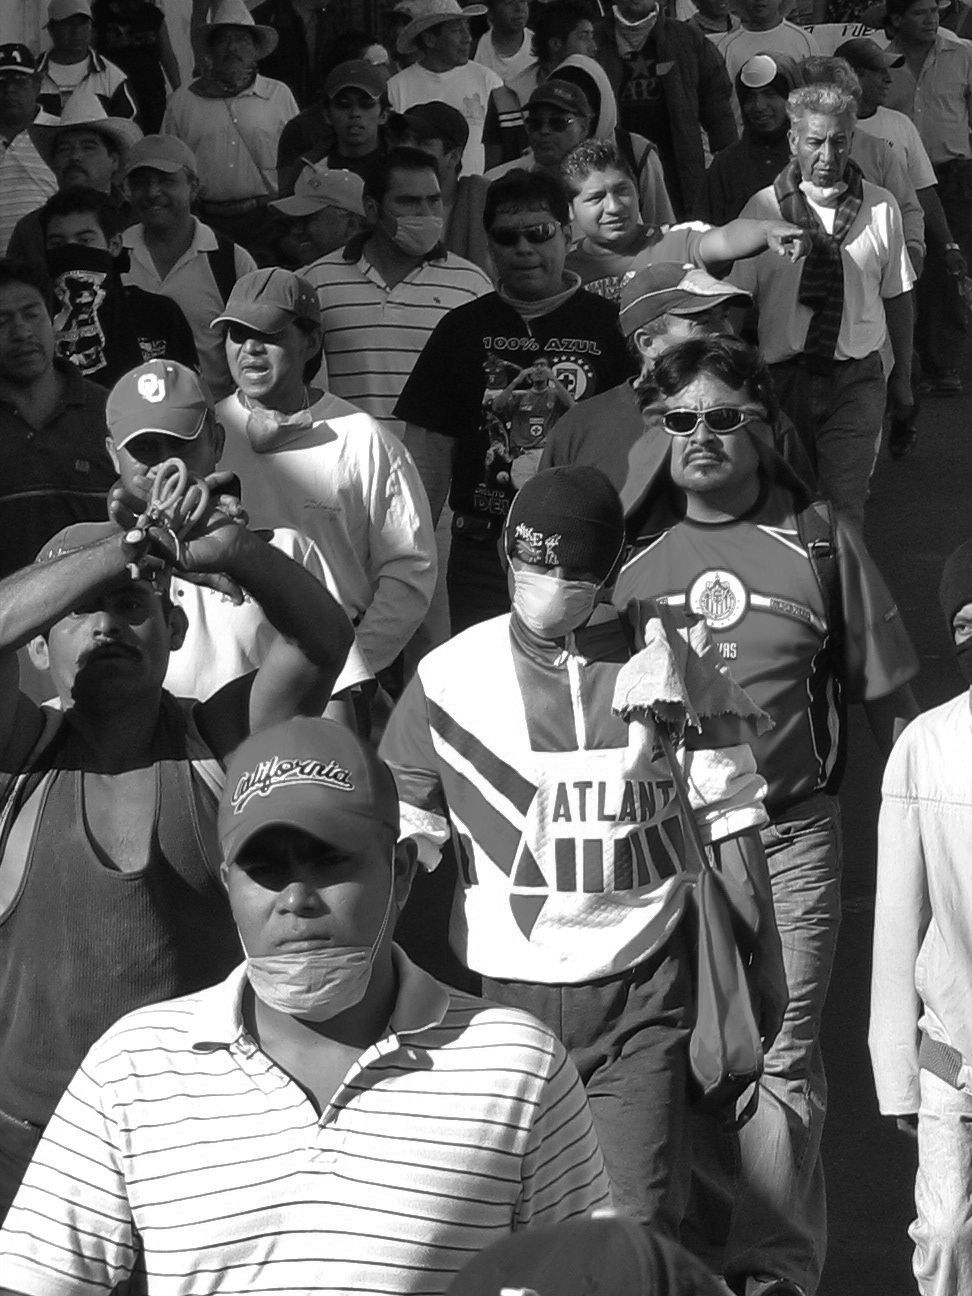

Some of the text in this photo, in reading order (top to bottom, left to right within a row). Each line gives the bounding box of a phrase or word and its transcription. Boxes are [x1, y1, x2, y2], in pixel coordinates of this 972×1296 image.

[482, 336, 602, 355] 100% AZUL
[230, 755, 356, 816] California
[551, 779, 675, 823] ATLANT
